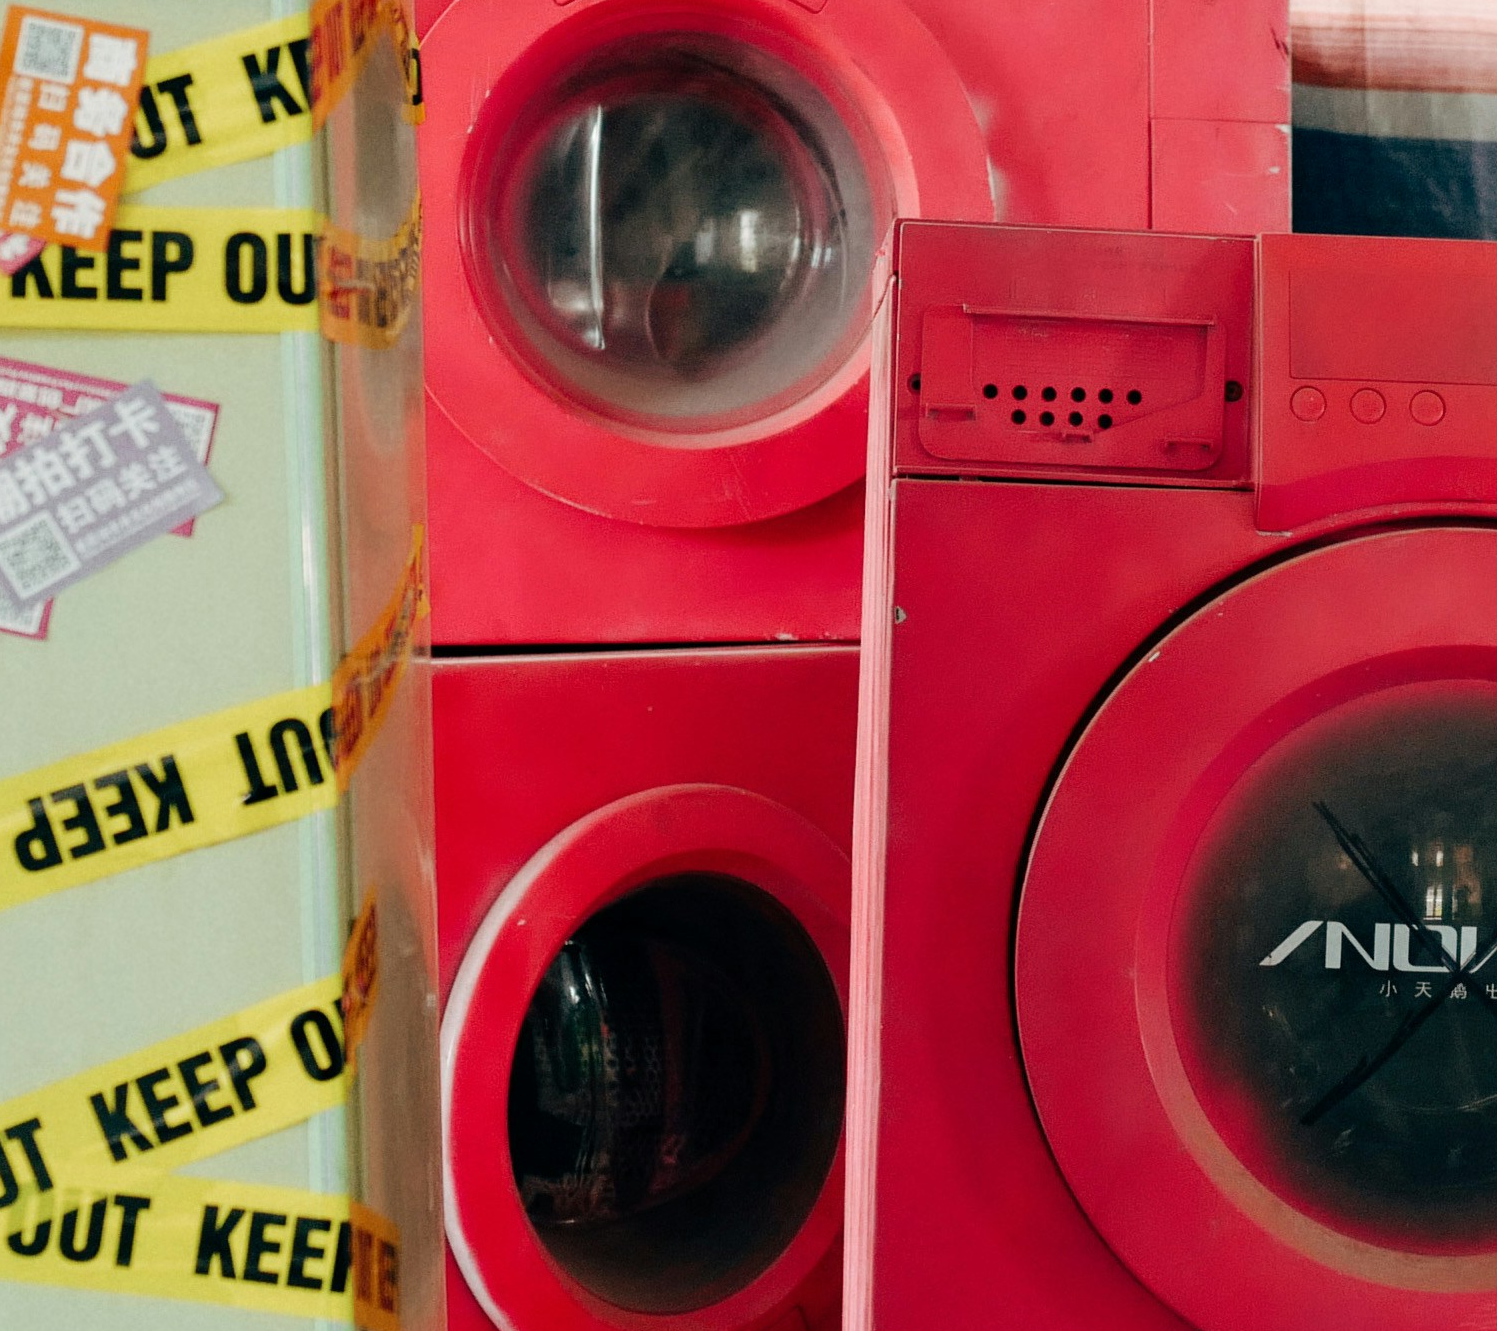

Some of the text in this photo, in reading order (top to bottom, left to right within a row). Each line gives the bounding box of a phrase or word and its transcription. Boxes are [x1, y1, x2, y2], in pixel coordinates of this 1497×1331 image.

[50, 32, 138, 240] 商务合作
[131, 73, 204, 159] UT
[224, 231, 319, 306] OU
[56, 443, 189, 535] 扫码关注
[12, 754, 198, 873] KEEP
[89, 1033, 268, 1164] KEEP
